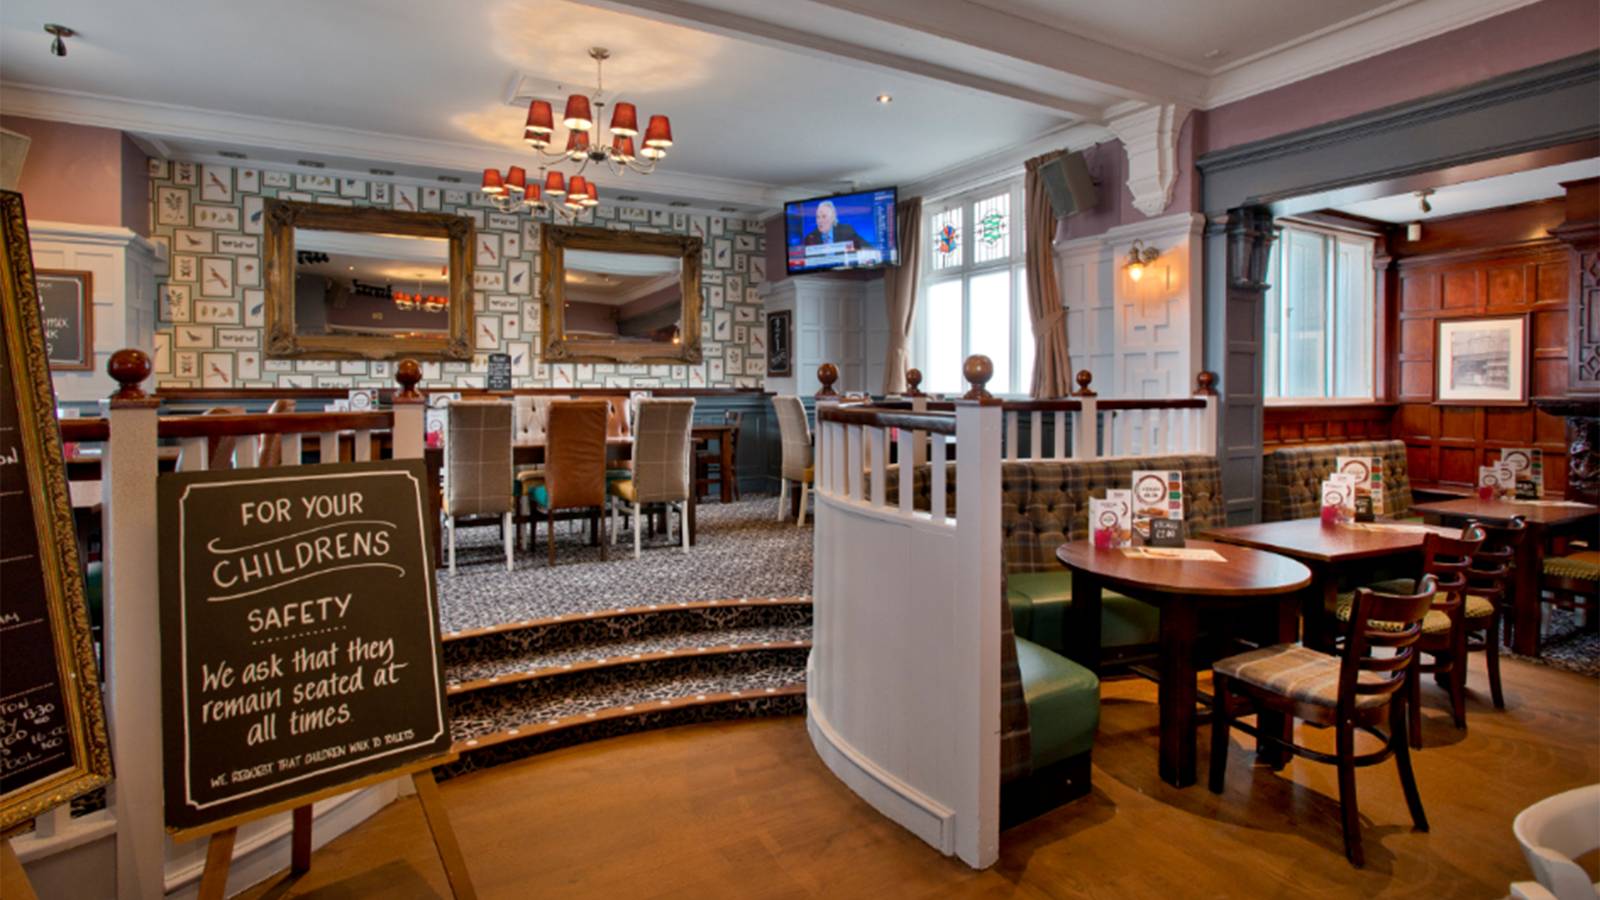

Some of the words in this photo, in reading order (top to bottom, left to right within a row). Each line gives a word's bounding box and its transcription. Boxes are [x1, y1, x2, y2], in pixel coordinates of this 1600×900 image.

[241, 498, 291, 526] FOR
[302, 492, 364, 519] YOUR
[212, 530, 391, 588] CHILDRENS
[247, 593, 352, 633] SAFETY
[201, 660, 235, 693] We
[242, 653, 284, 684] ask
[292, 639, 338, 674] that
[346, 637, 396, 665] they
[202, 687, 282, 724] remain
[293, 669, 364, 705] seated
[373, 662, 409, 687] at
[246, 715, 276, 746] all
[289, 703, 351, 736] times
[210, 773, 229, 788] WE
[277, 755, 301, 774] THAT
[304, 745, 347, 764] CHILDREN
[349, 742, 371, 754] WALK
[372, 737, 382, 749] TO
[385, 729, 415, 745] TOILETS
